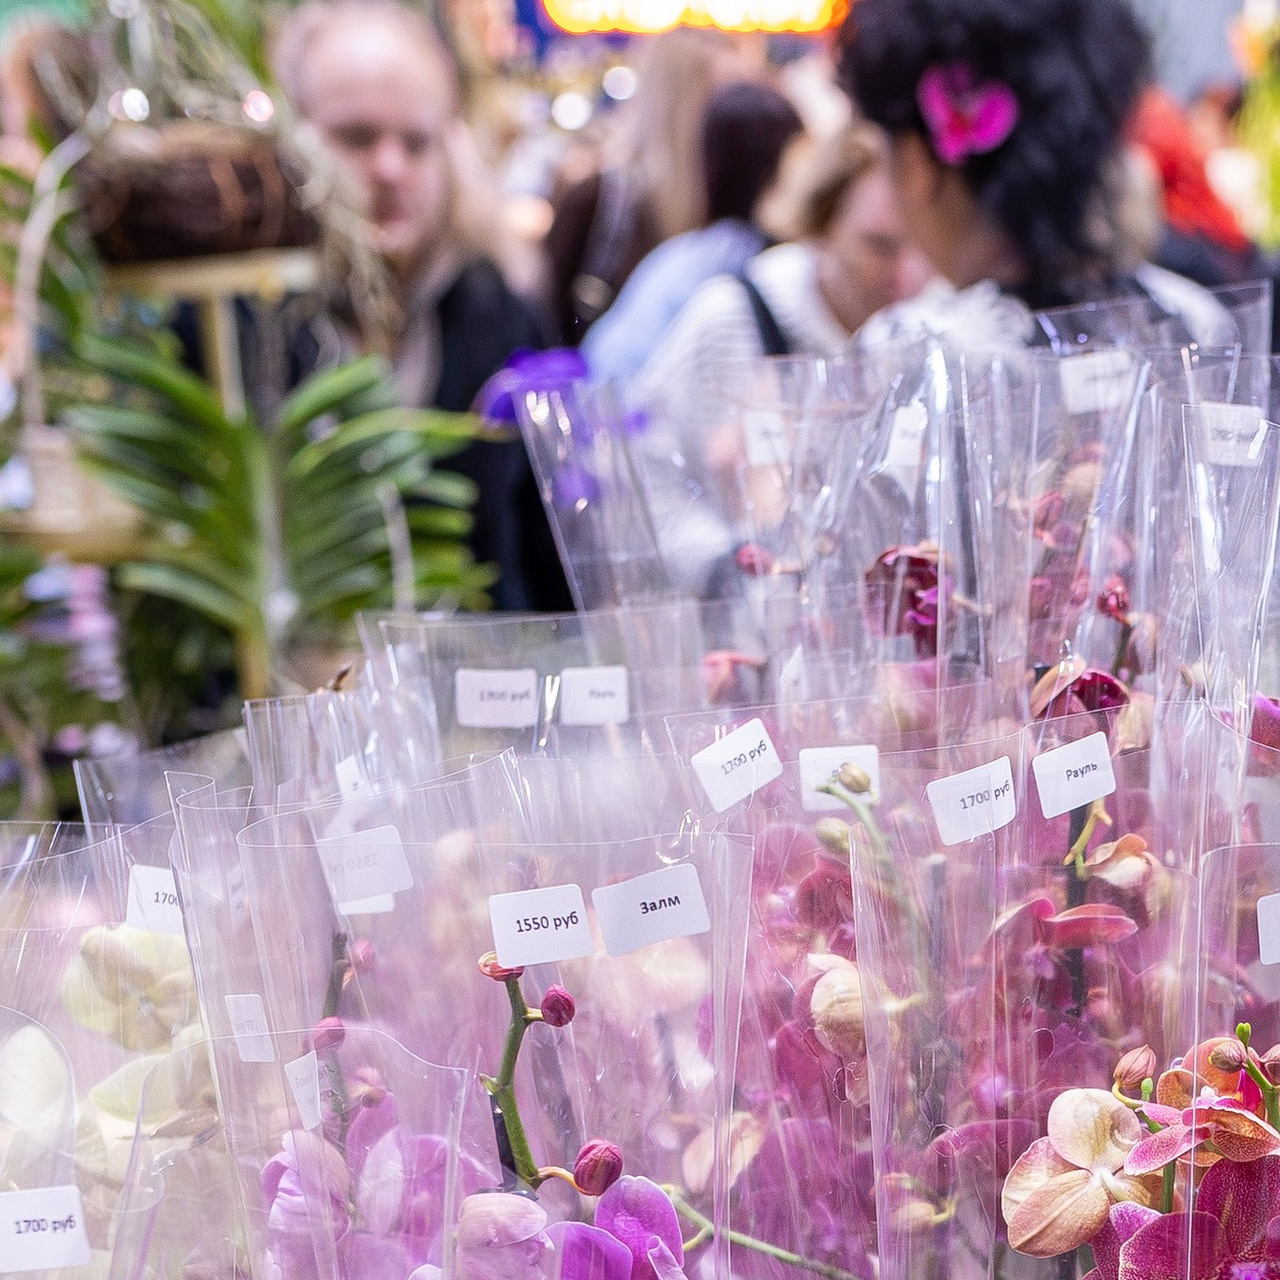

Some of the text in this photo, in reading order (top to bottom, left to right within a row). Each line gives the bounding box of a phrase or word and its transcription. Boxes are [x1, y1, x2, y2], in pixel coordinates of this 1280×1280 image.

[720, 739, 768, 776] 1700 руб
[1065, 761, 1098, 782] Рауль
[959, 780, 1010, 811] 1700 руб
[639, 895, 681, 914] Залм
[516, 911, 579, 933] 1550 руб
